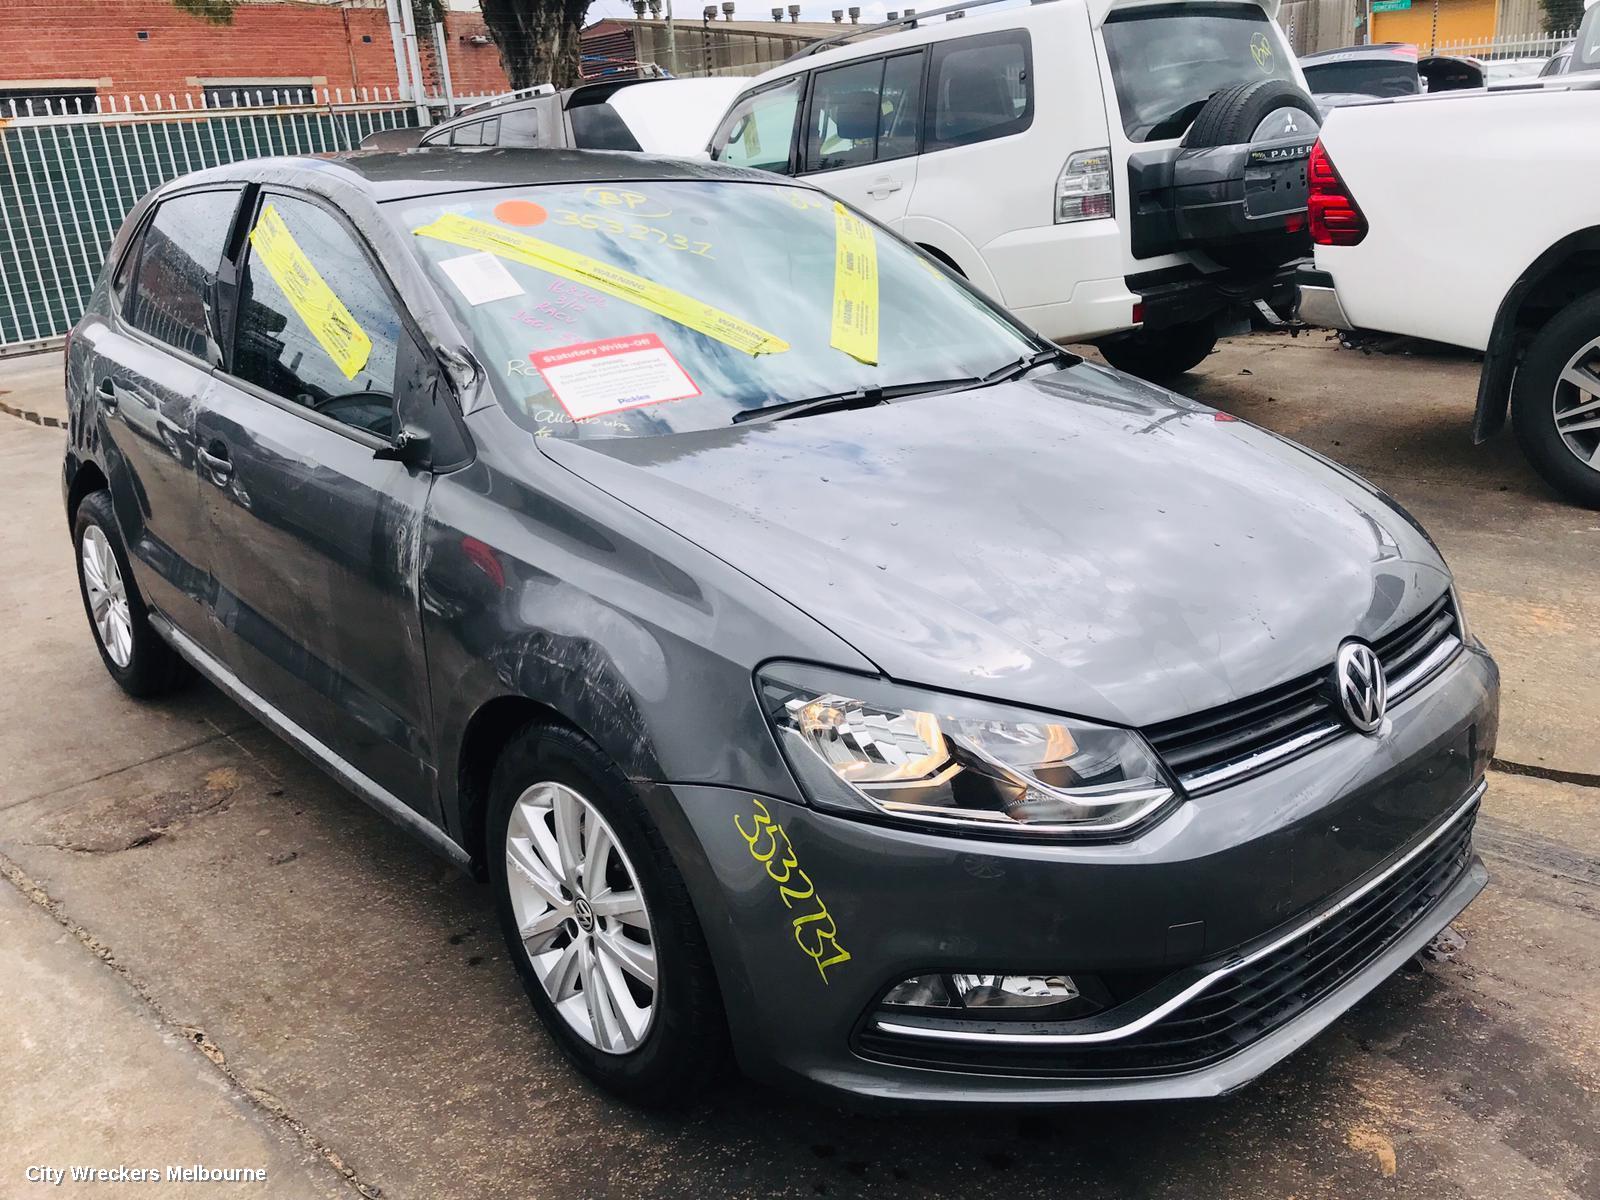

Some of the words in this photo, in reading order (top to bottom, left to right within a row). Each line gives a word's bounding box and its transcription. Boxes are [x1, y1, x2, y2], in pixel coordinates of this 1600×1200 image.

[1271, 145, 1313, 158] PAJER
[553, 208, 717, 261] 3532731
[593, 266, 646, 291] WARNING
[543, 347, 598, 364] Statutory
[618, 393, 650, 405] Pickles
[734, 798, 851, 985] 3532731
